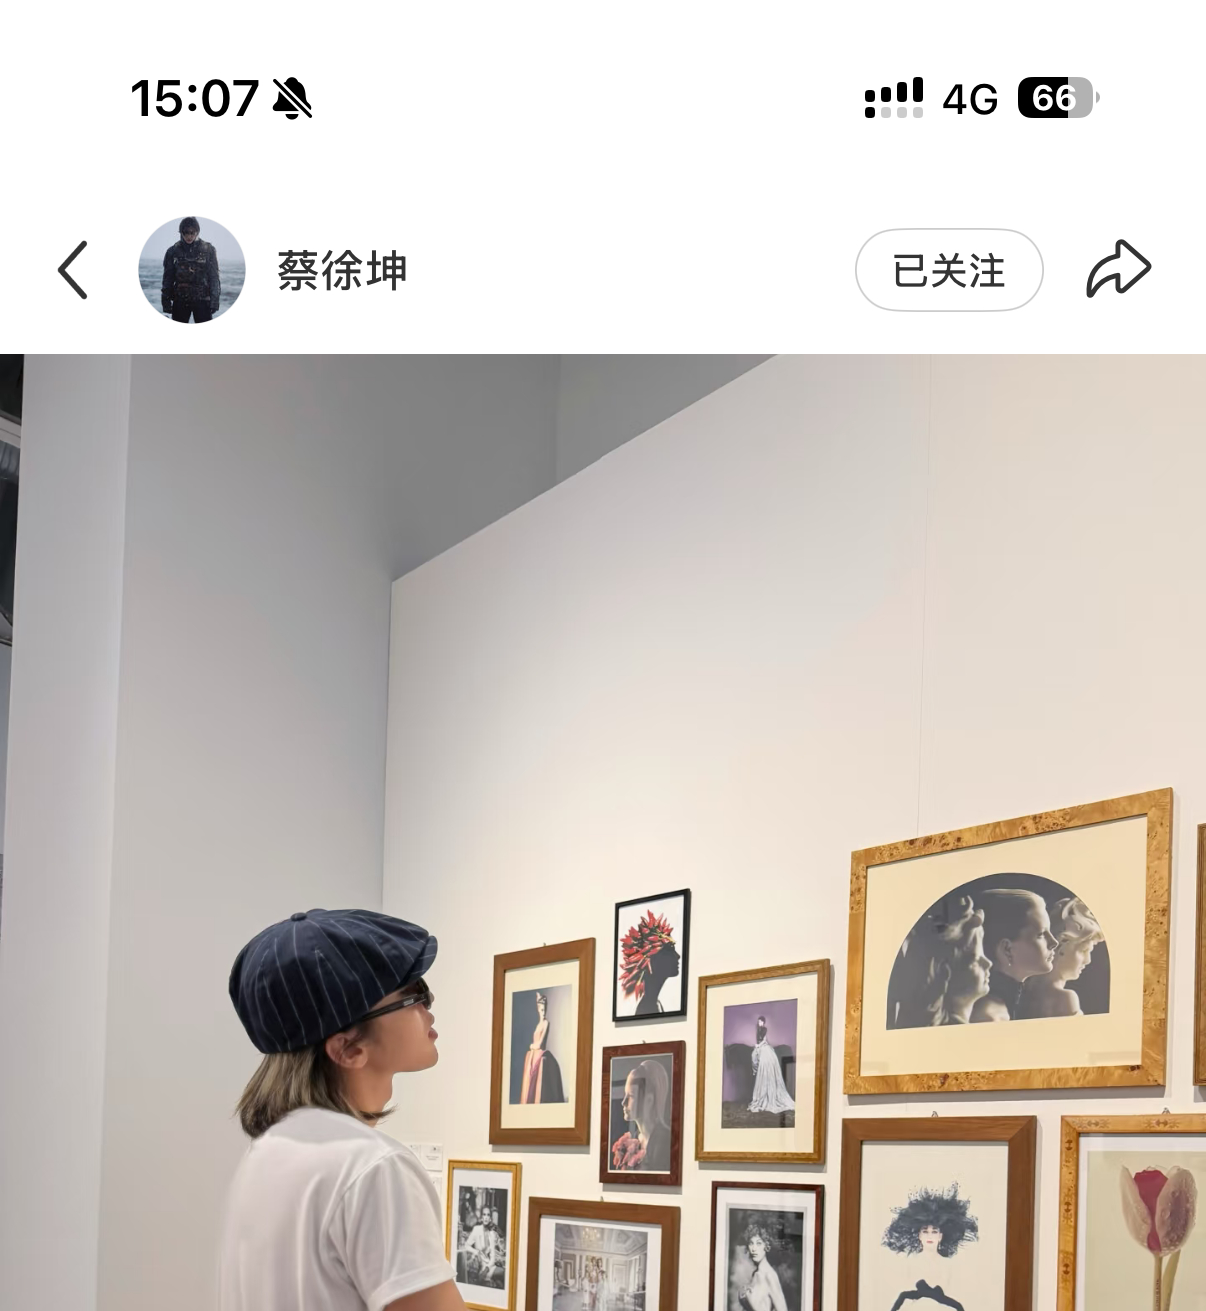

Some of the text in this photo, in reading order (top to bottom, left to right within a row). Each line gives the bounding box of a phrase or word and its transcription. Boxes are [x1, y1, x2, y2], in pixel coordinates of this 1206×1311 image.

[132, 79, 260, 117] 15:07
[943, 83, 997, 115] 4G
[1033, 84, 1076, 111] 66
[278, 250, 406, 291] 蔡徐坤
[894, 253, 1004, 288] 已关注
